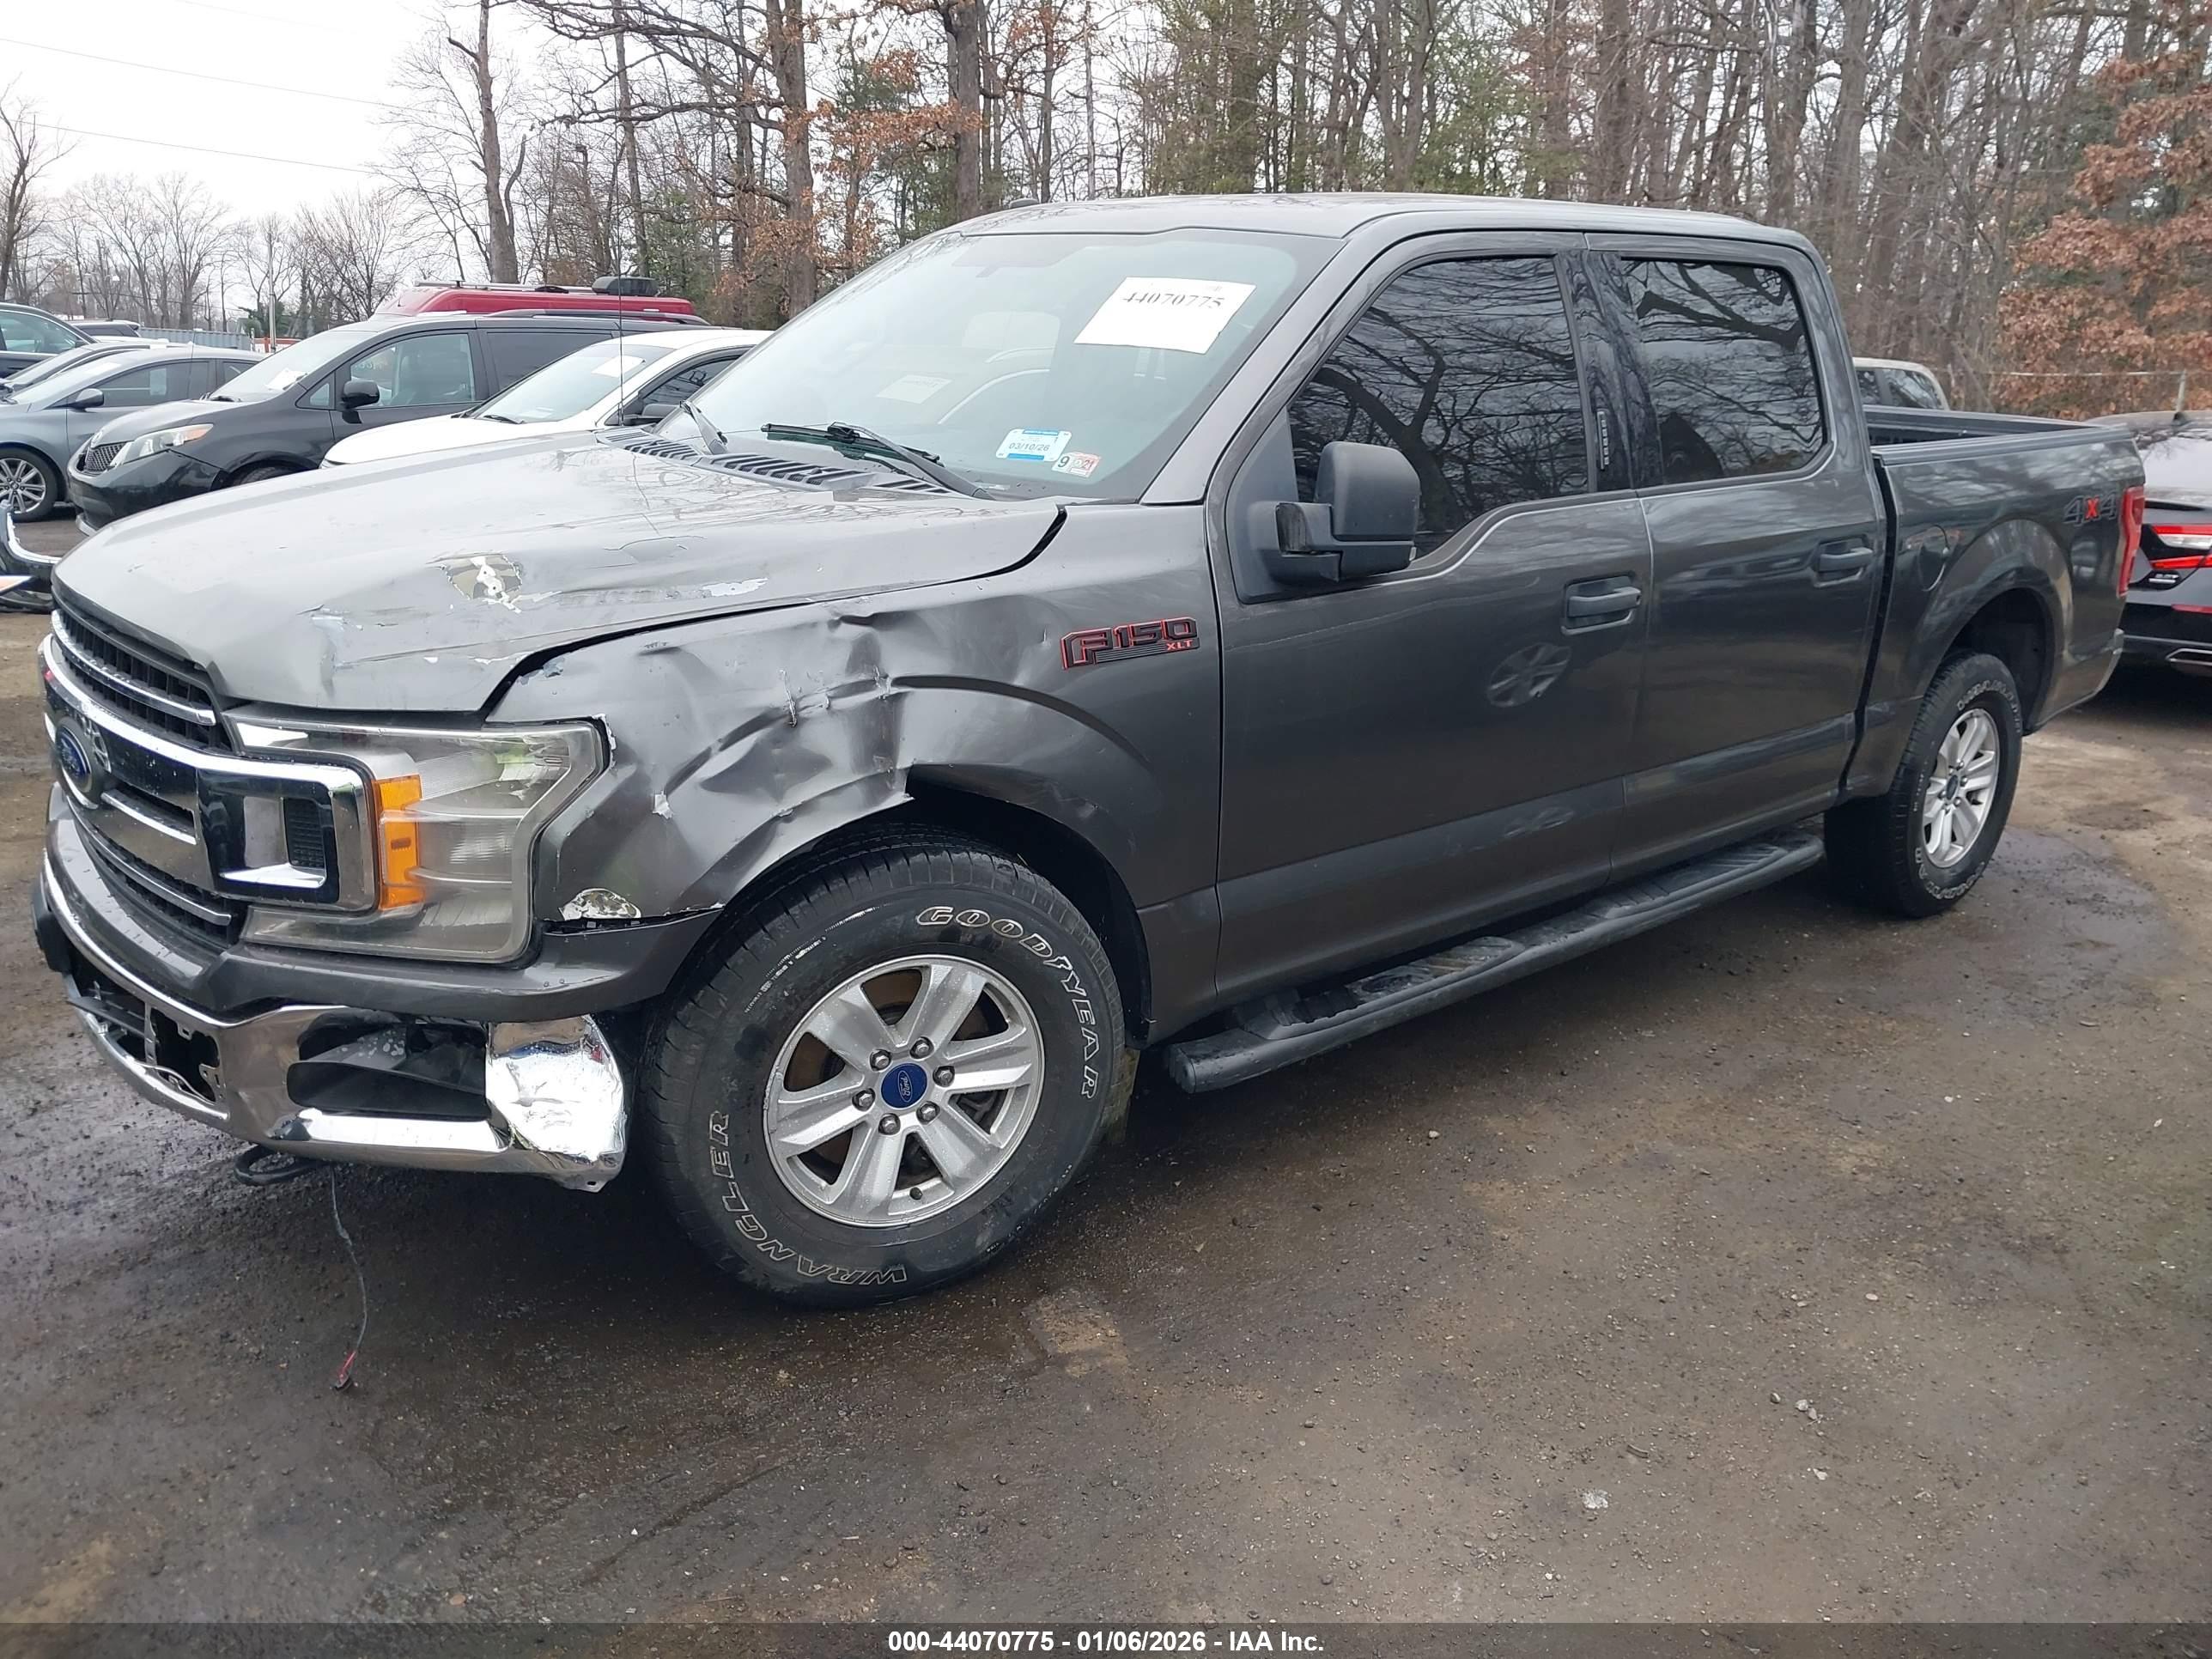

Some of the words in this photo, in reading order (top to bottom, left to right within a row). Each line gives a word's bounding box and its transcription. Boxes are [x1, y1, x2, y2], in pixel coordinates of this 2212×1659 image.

[1122, 292, 1225, 308] 44070775
[1008, 441, 1050, 452] 03/10/26
[1057, 455, 1070, 468] 9
[1060, 616, 1198, 670] F150
[1165, 639, 1194, 651] XLT
[915, 905, 1100, 1100] GOODYEAR
[708, 1109, 908, 1285] WRANGLER
